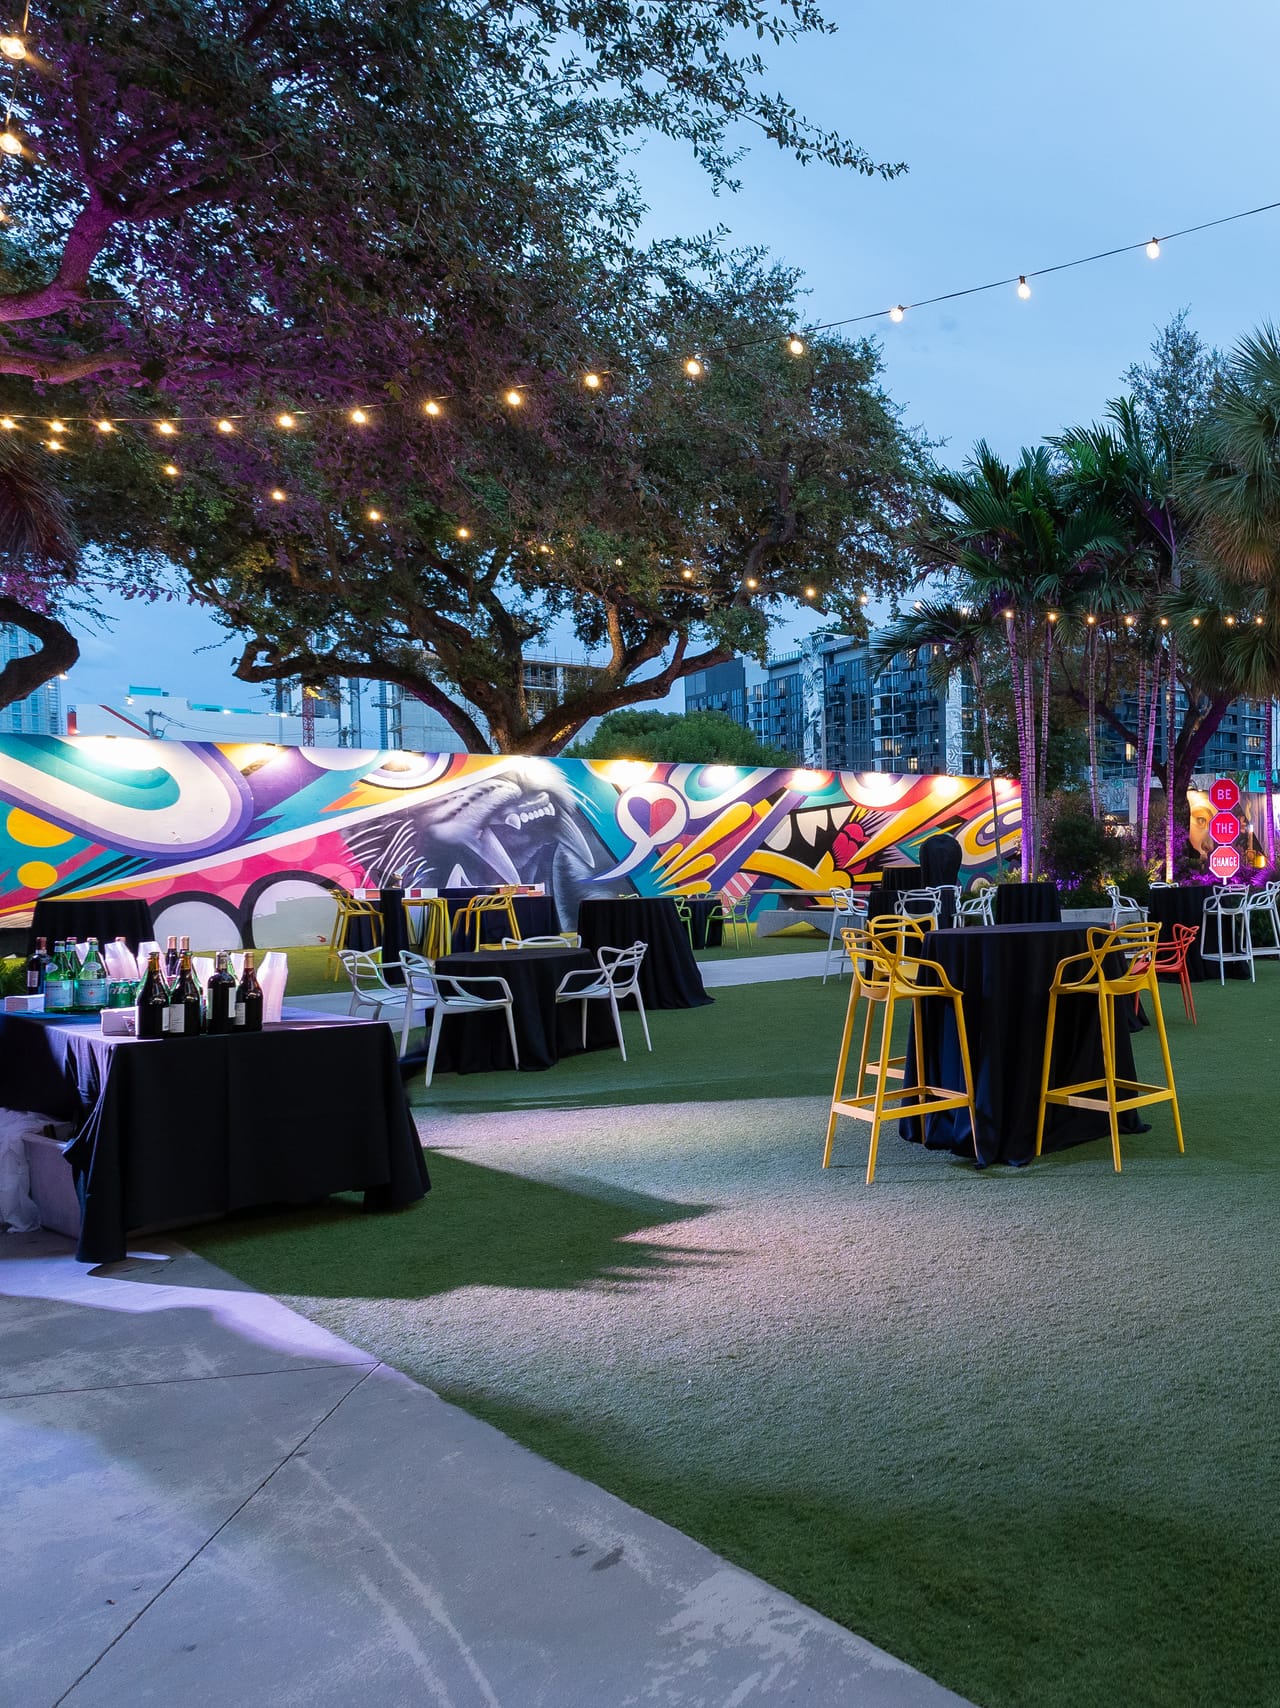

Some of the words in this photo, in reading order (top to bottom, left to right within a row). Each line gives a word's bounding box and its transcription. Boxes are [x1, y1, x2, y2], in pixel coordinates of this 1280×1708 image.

[1217, 789, 1232, 800] BE
[1216, 823, 1234, 834] THE
[1212, 856, 1238, 867] CHANGE
